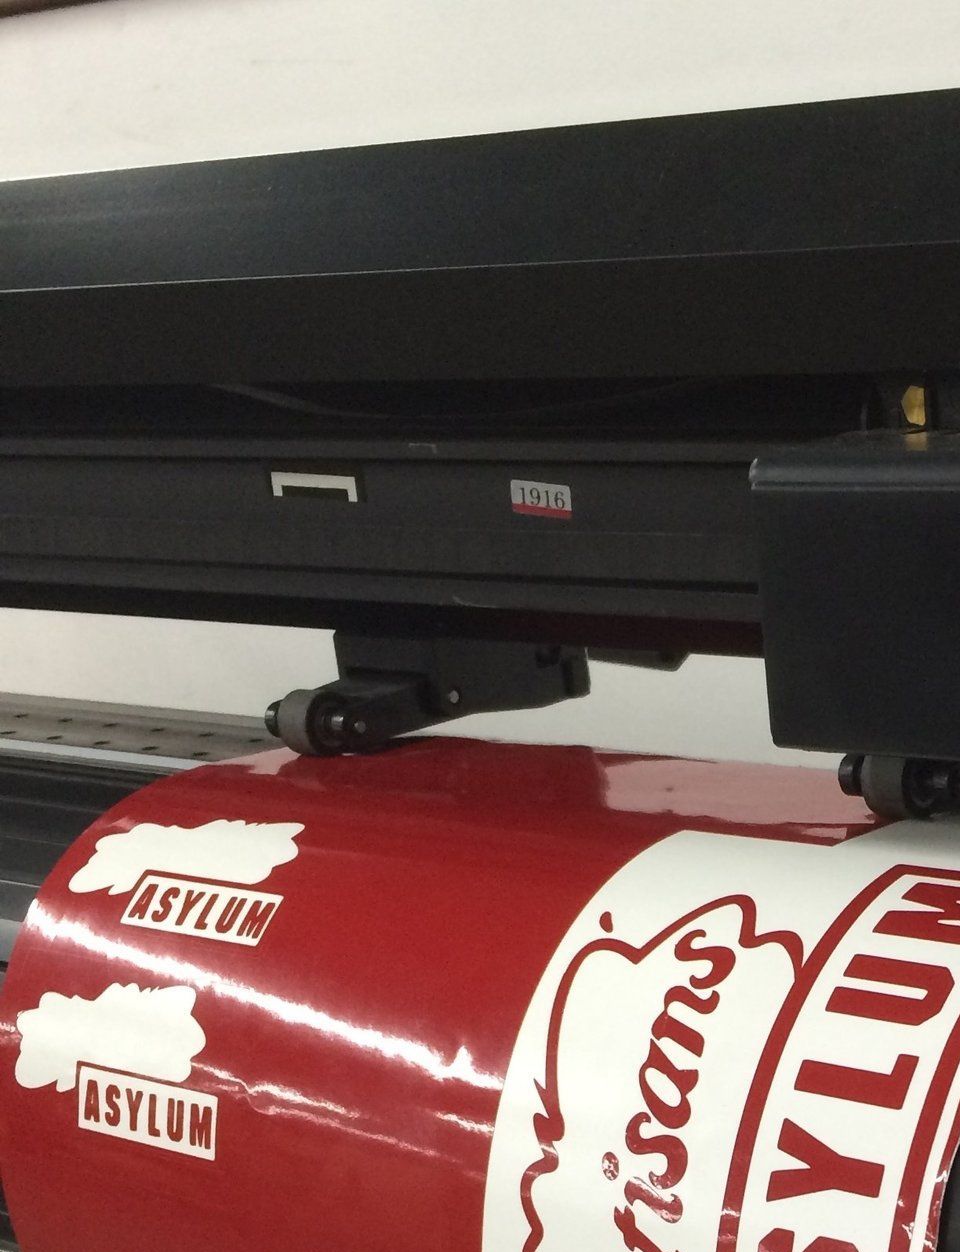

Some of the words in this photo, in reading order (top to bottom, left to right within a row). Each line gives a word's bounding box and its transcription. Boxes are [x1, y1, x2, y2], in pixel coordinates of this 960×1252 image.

[518, 487, 566, 510] 1916
[128, 882, 277, 940] ASYLUM
[84, 1079, 213, 1150] ASYLUM
